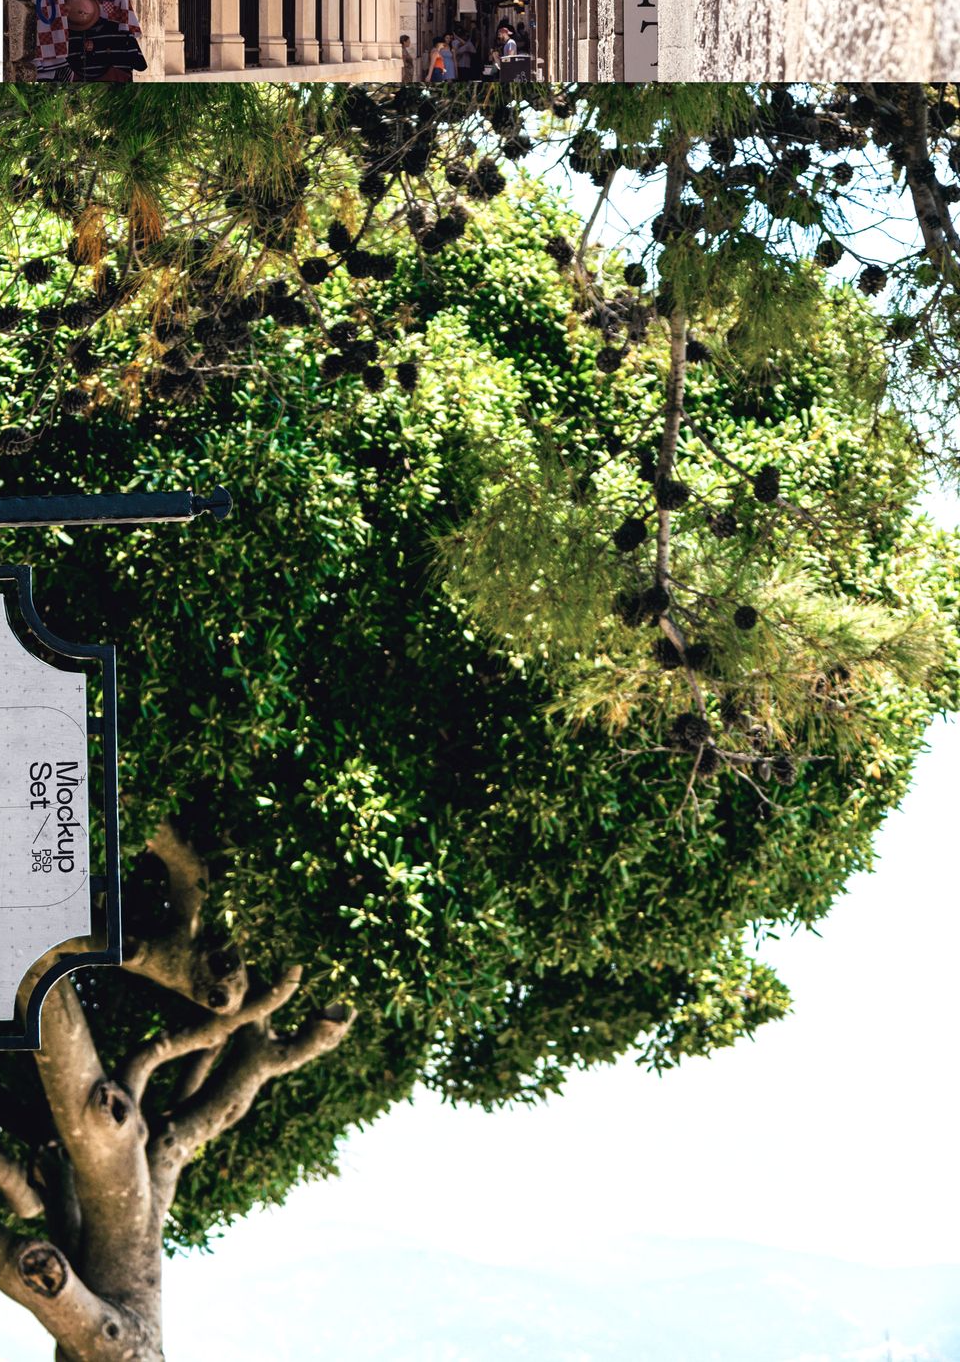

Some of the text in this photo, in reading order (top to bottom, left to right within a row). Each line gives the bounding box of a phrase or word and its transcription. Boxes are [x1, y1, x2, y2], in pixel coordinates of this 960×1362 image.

[29, 761, 53, 810] Set
[52, 761, 81, 873] Mockup
[31, 849, 42, 872] JPG
[42, 848, 52, 873] PSD
